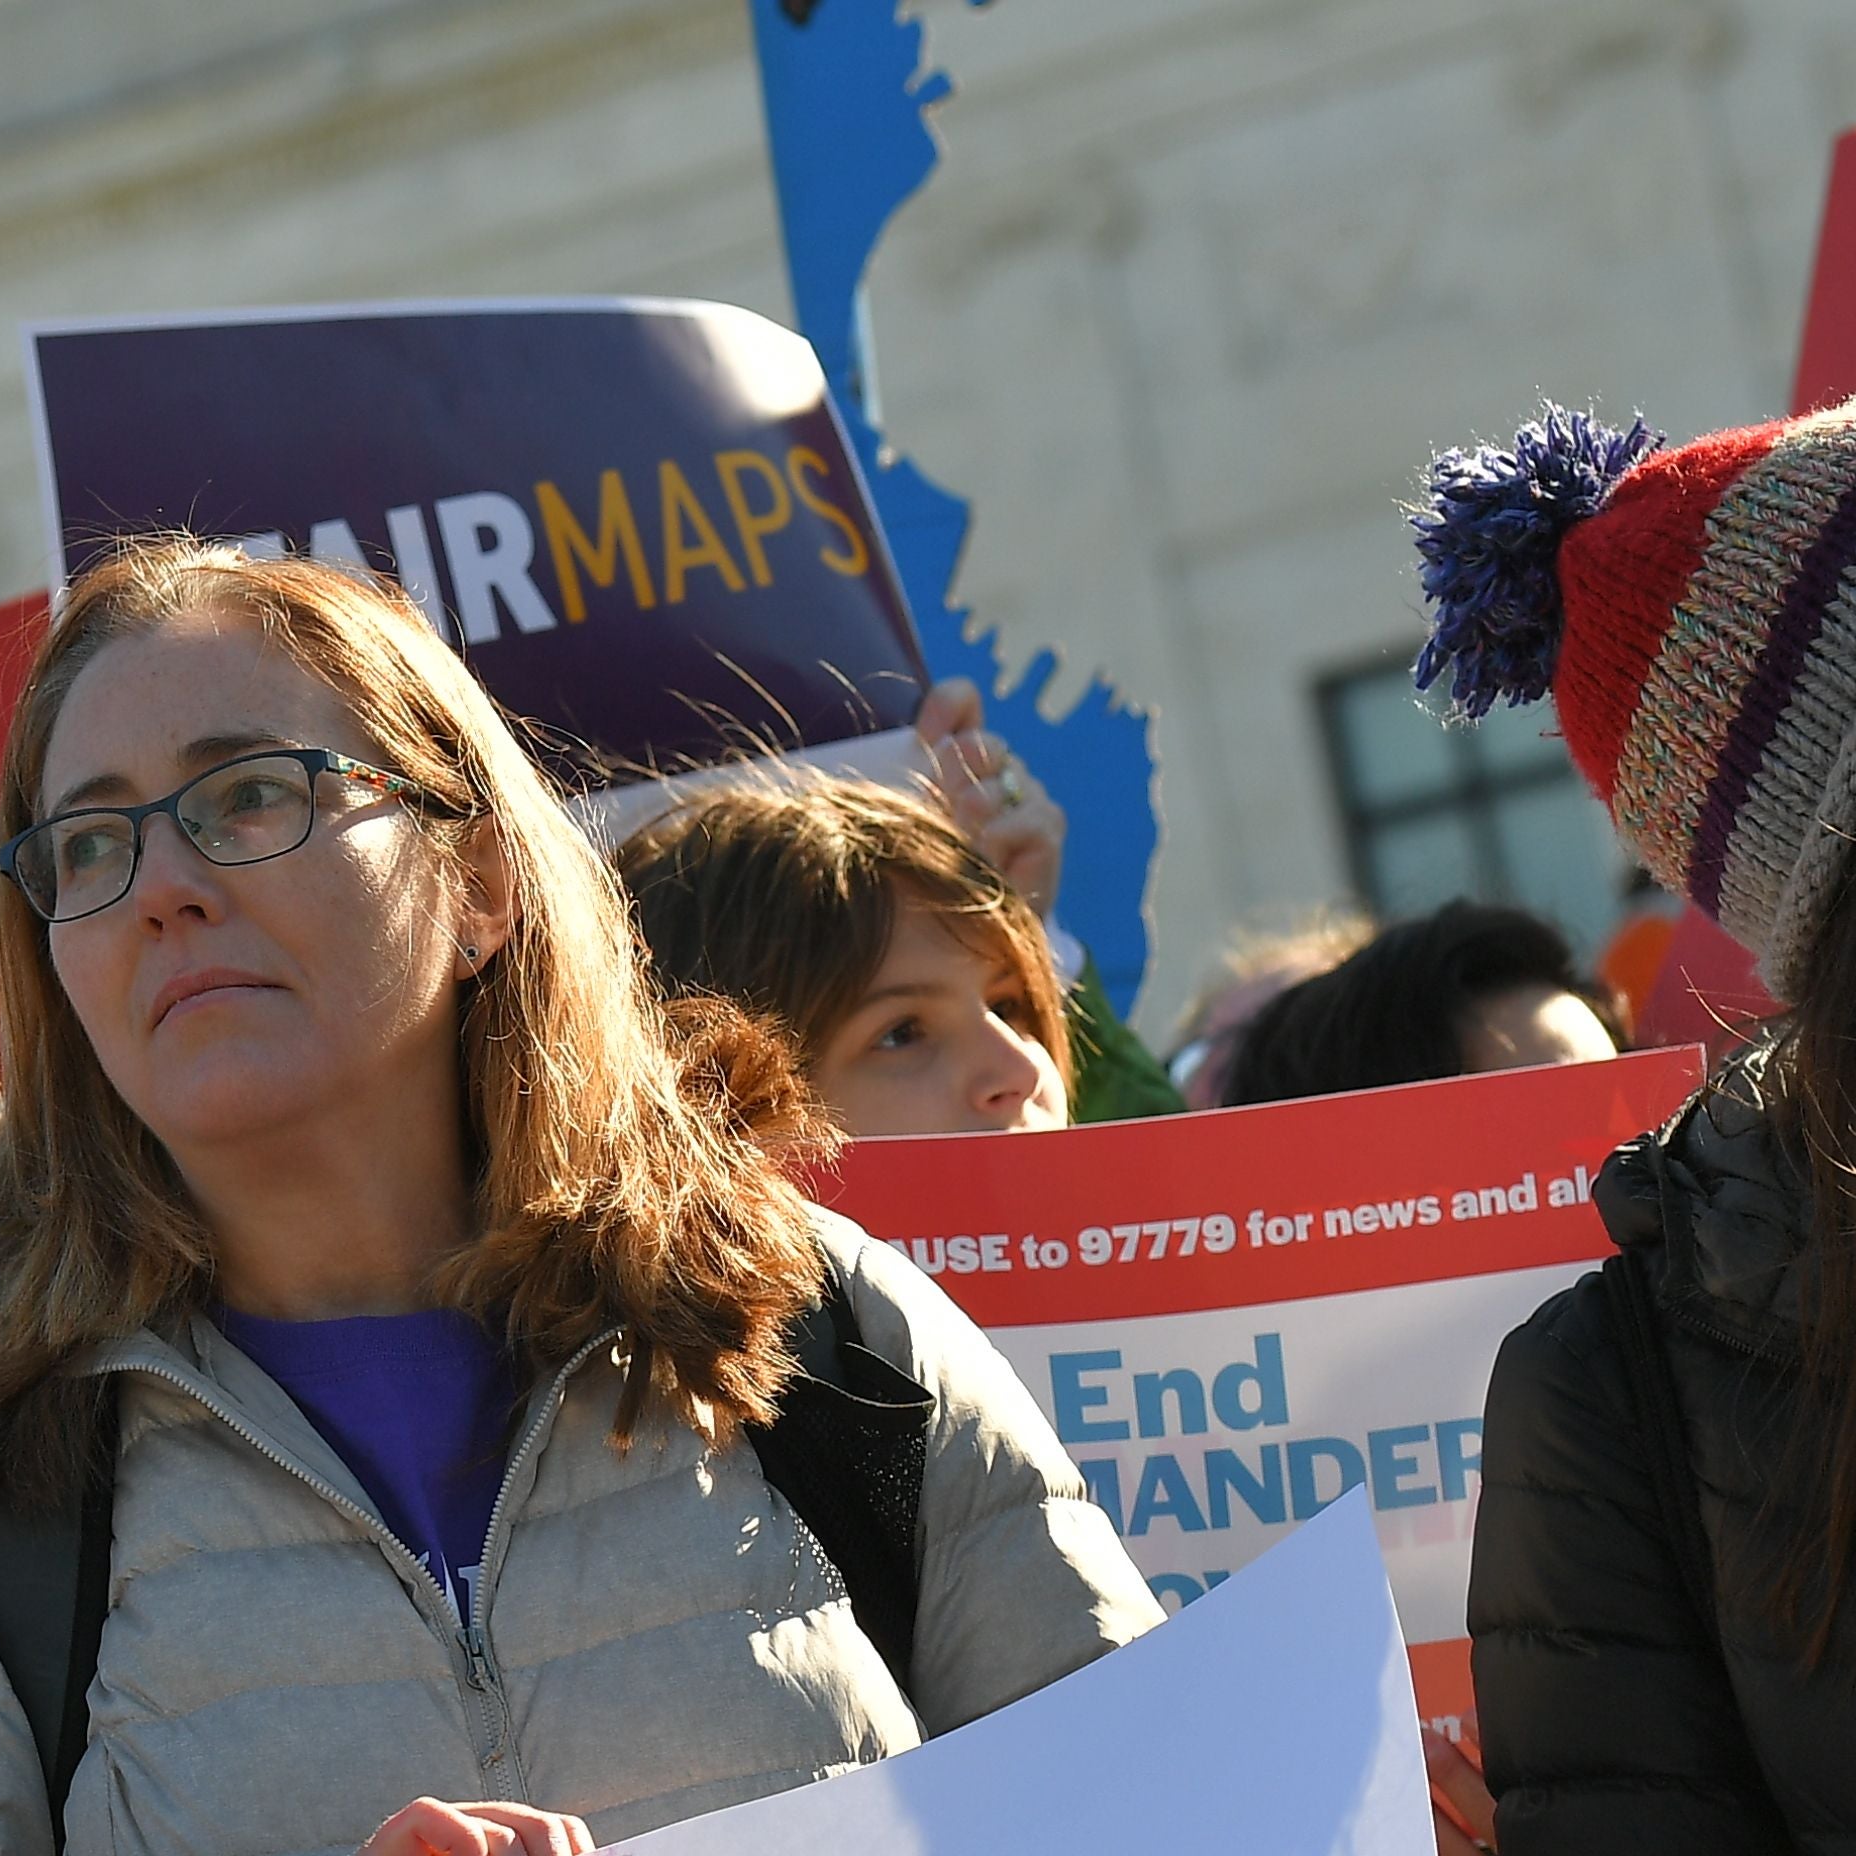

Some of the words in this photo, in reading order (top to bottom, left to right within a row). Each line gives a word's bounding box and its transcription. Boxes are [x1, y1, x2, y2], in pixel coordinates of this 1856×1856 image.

[1021, 1233, 1069, 1269] to
[1077, 1213, 1237, 1266] 97779
[1245, 1208, 1314, 1249] for
[1324, 1191, 1441, 1238] news
[1450, 1172, 1539, 1223] and
[1547, 1164, 1600, 1209] al
[1048, 1332, 1290, 1444] End
